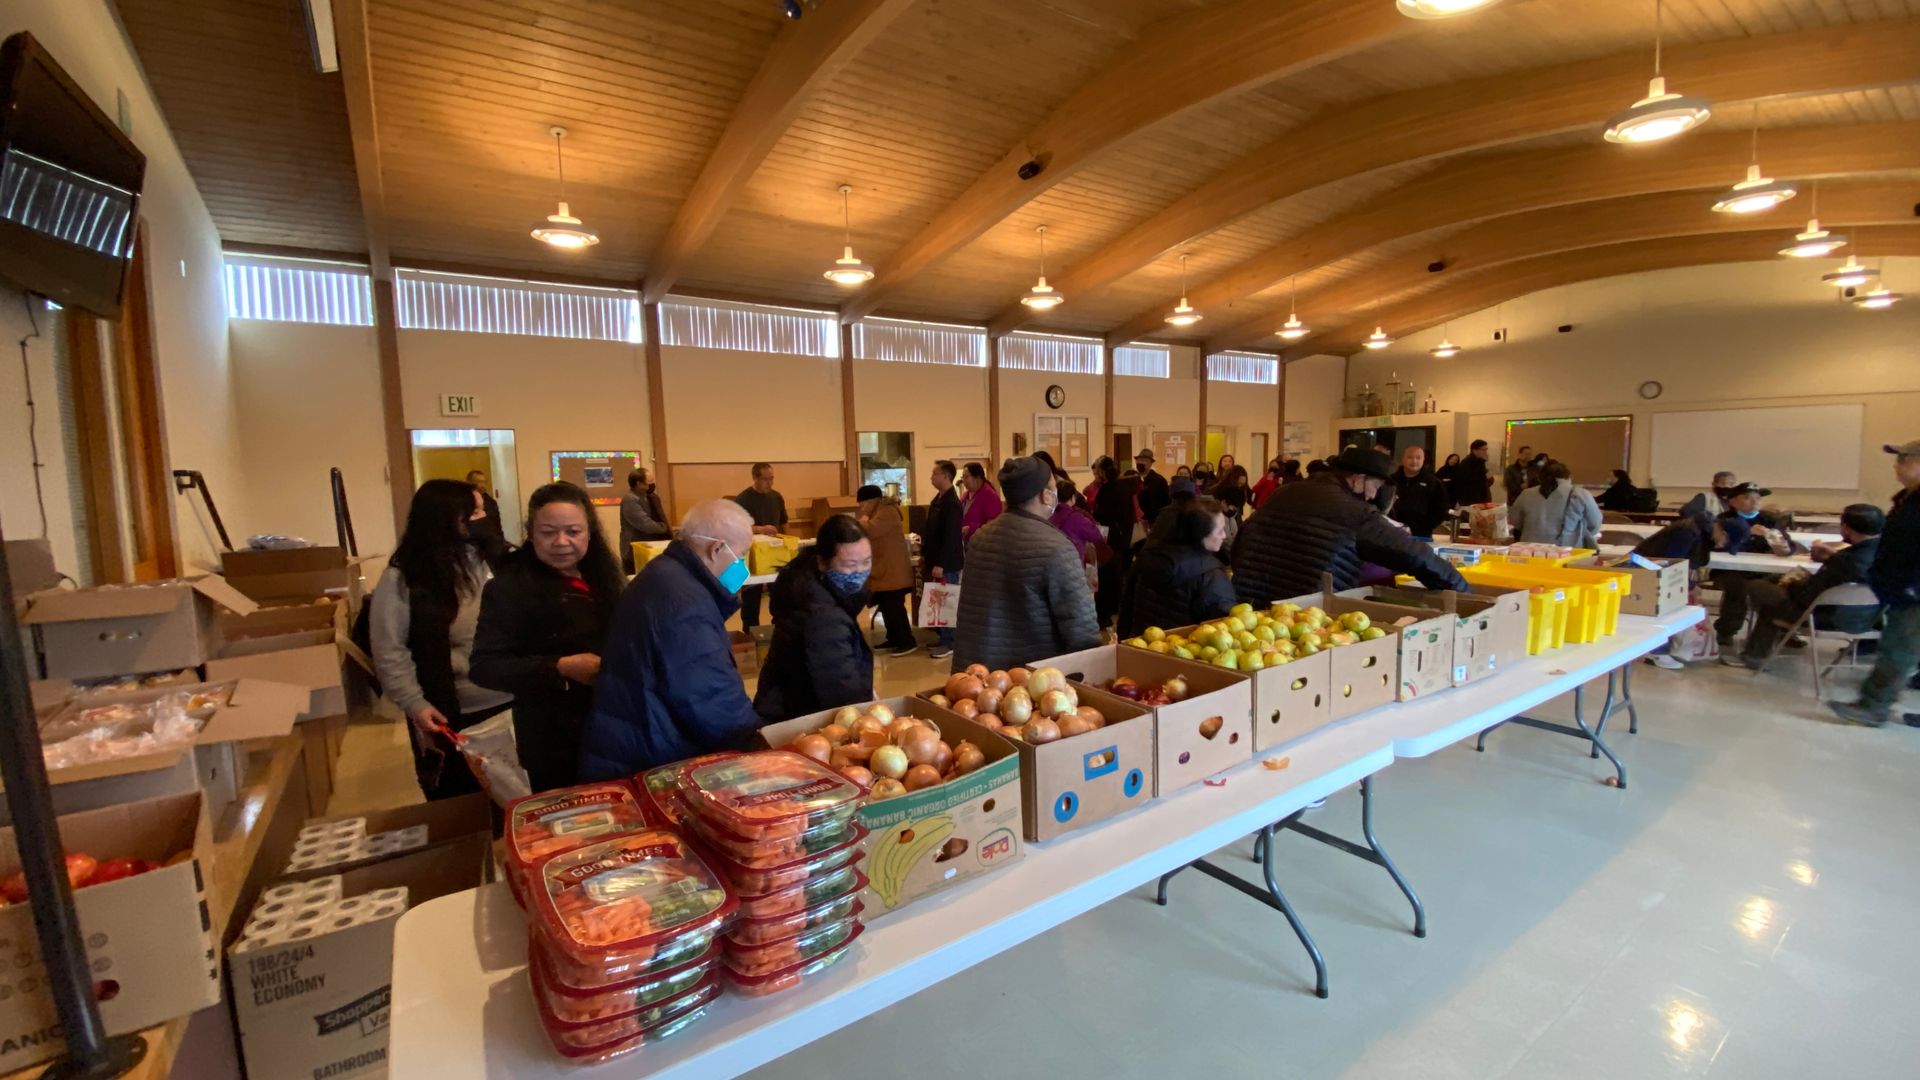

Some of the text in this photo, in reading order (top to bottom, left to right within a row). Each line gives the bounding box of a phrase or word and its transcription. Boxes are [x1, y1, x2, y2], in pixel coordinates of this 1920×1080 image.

[448, 396, 474, 412] EXIT
[534, 792, 612, 816] GOOD TIMES
[948, 782, 983, 807] CERTIFIED
[908, 800, 946, 816] ORGANIC
[982, 838, 1009, 860] Dole
[571, 846, 664, 878] GOOD TIMES
[251, 965, 298, 989] WHITE
[254, 973, 326, 1006] ECONOMY
[313, 1047, 386, 1080] BATHROOM
